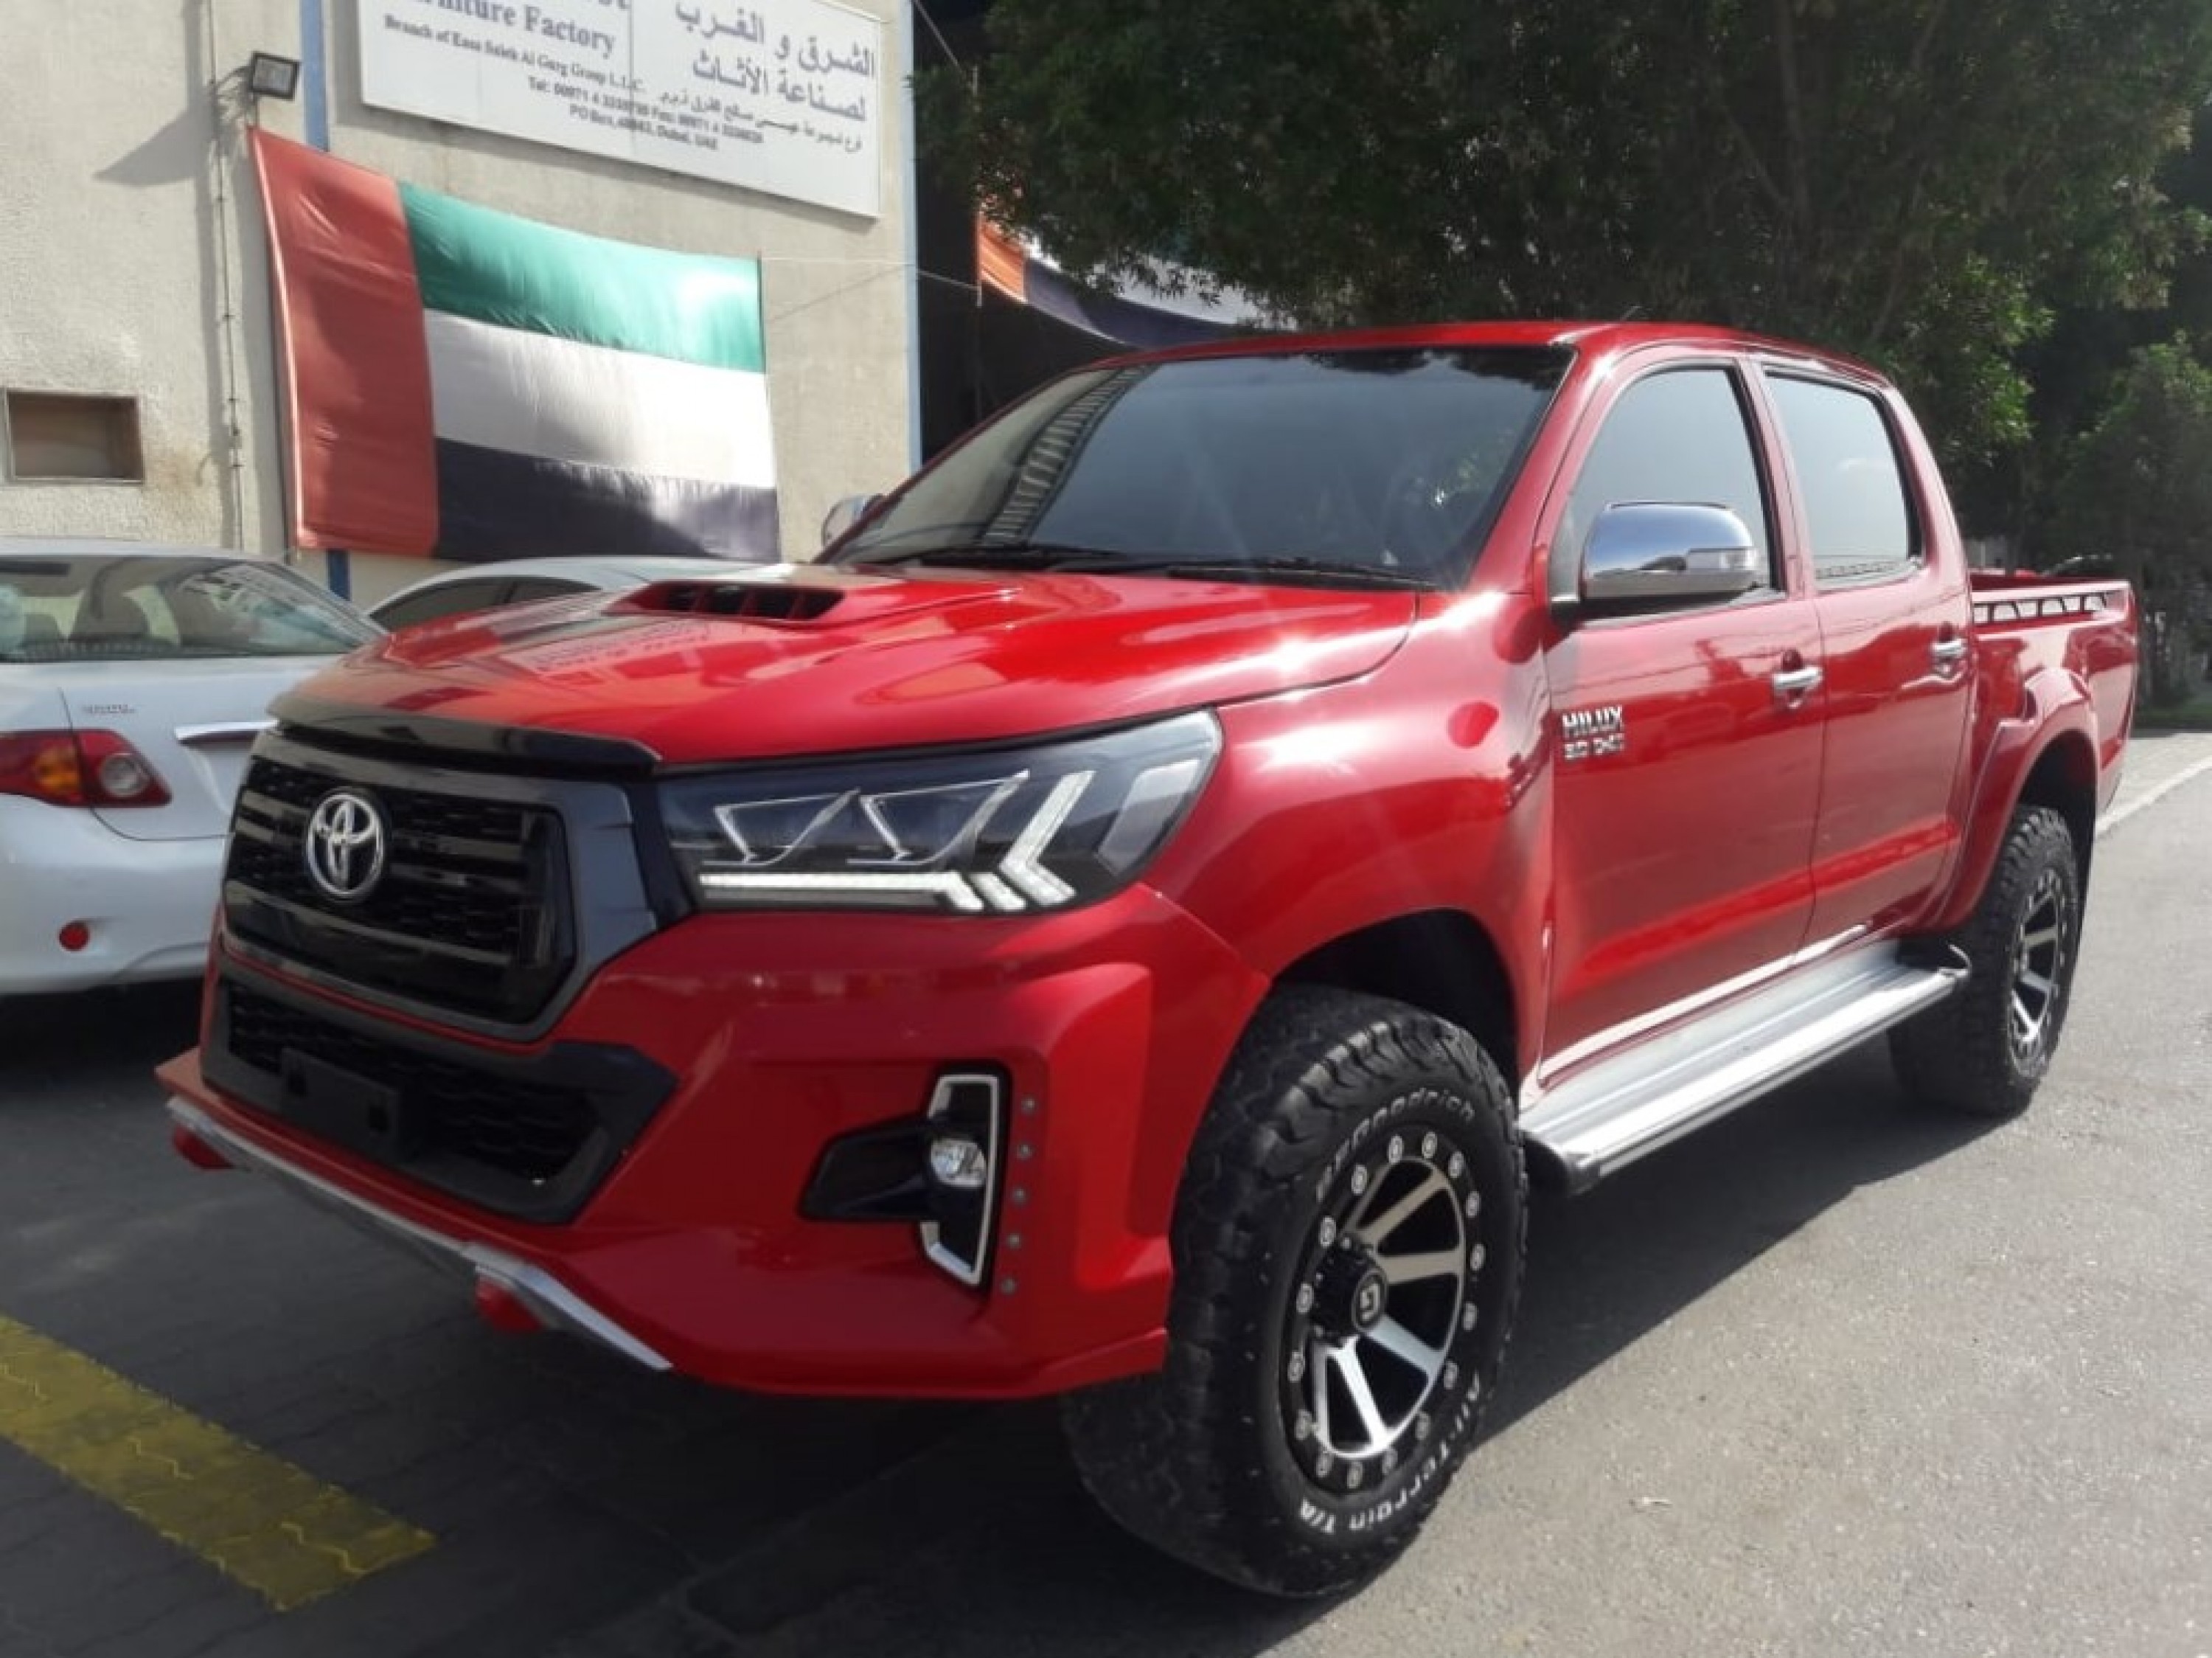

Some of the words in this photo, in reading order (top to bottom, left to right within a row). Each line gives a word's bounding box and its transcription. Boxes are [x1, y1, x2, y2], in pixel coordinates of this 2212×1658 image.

[524, 4, 616, 60] Factory
[675, 1, 765, 44] الغرب
[384, 14, 432, 39] Branch
[436, 30, 451, 43] of
[484, 39, 518, 61] Saleh
[521, 52, 536, 65] Al
[537, 55, 569, 77] Gurg
[571, 63, 606, 86] Group
[776, 35, 790, 60] و
[799, 35, 874, 80] الشرق
[528, 76, 551, 94] Tel:
[776, 68, 867, 122] لصناعة
[568, 103, 588, 119] PO
[1562, 705, 1624, 738] HILUX
